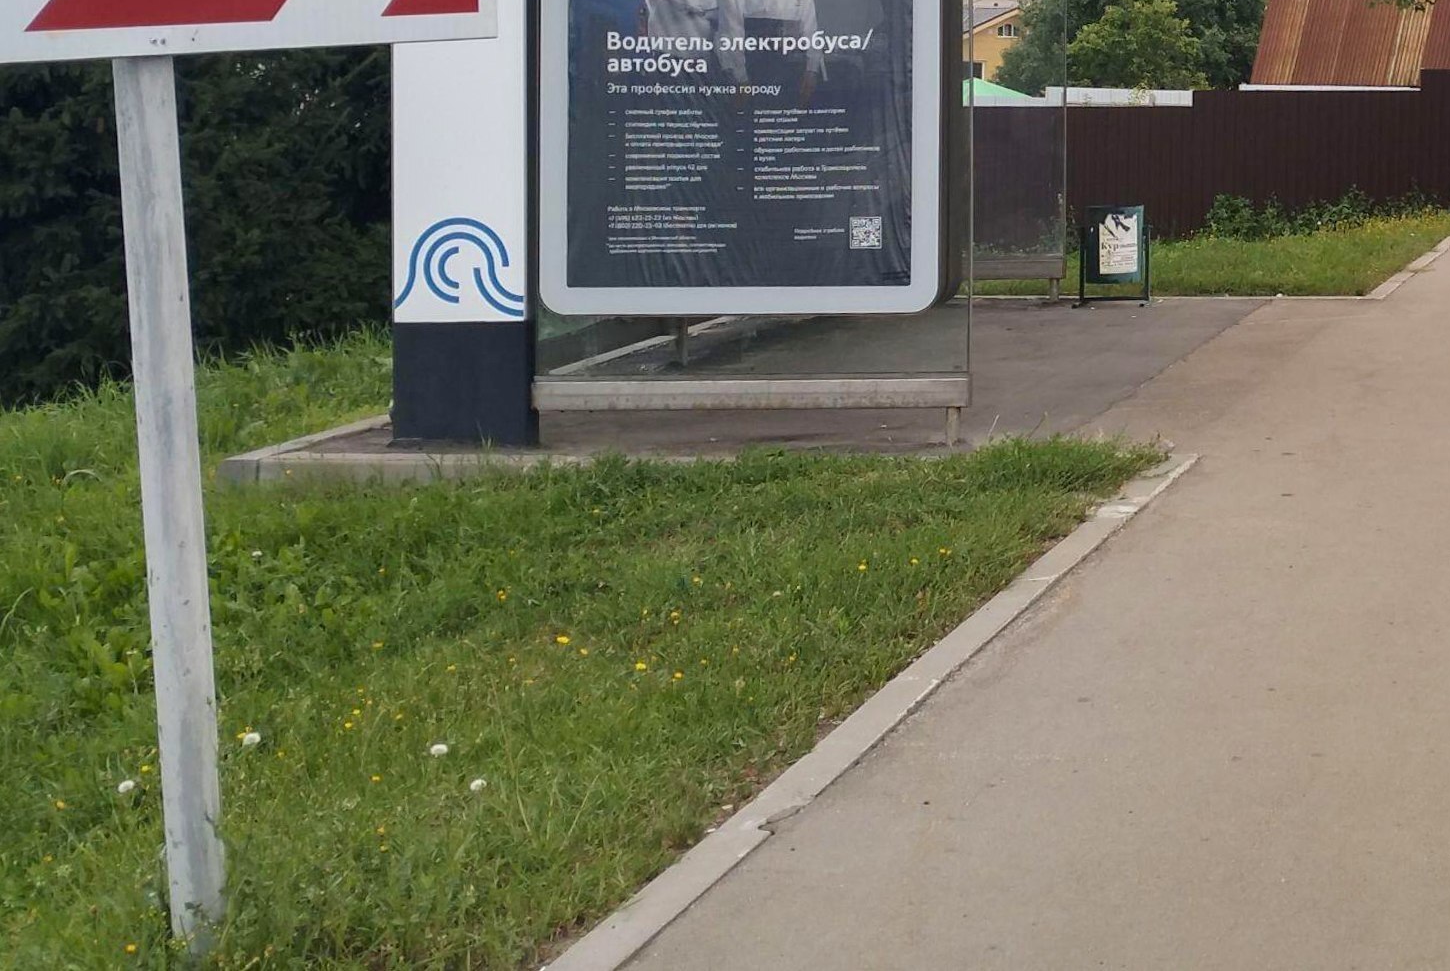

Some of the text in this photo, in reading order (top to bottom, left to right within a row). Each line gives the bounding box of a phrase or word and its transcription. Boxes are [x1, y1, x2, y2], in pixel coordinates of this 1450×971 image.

[607, 29, 873, 54] Водитель электробуса/
[607, 54, 708, 76] автобуса
[607, 82, 782, 96] Эта профессия нужна городу
